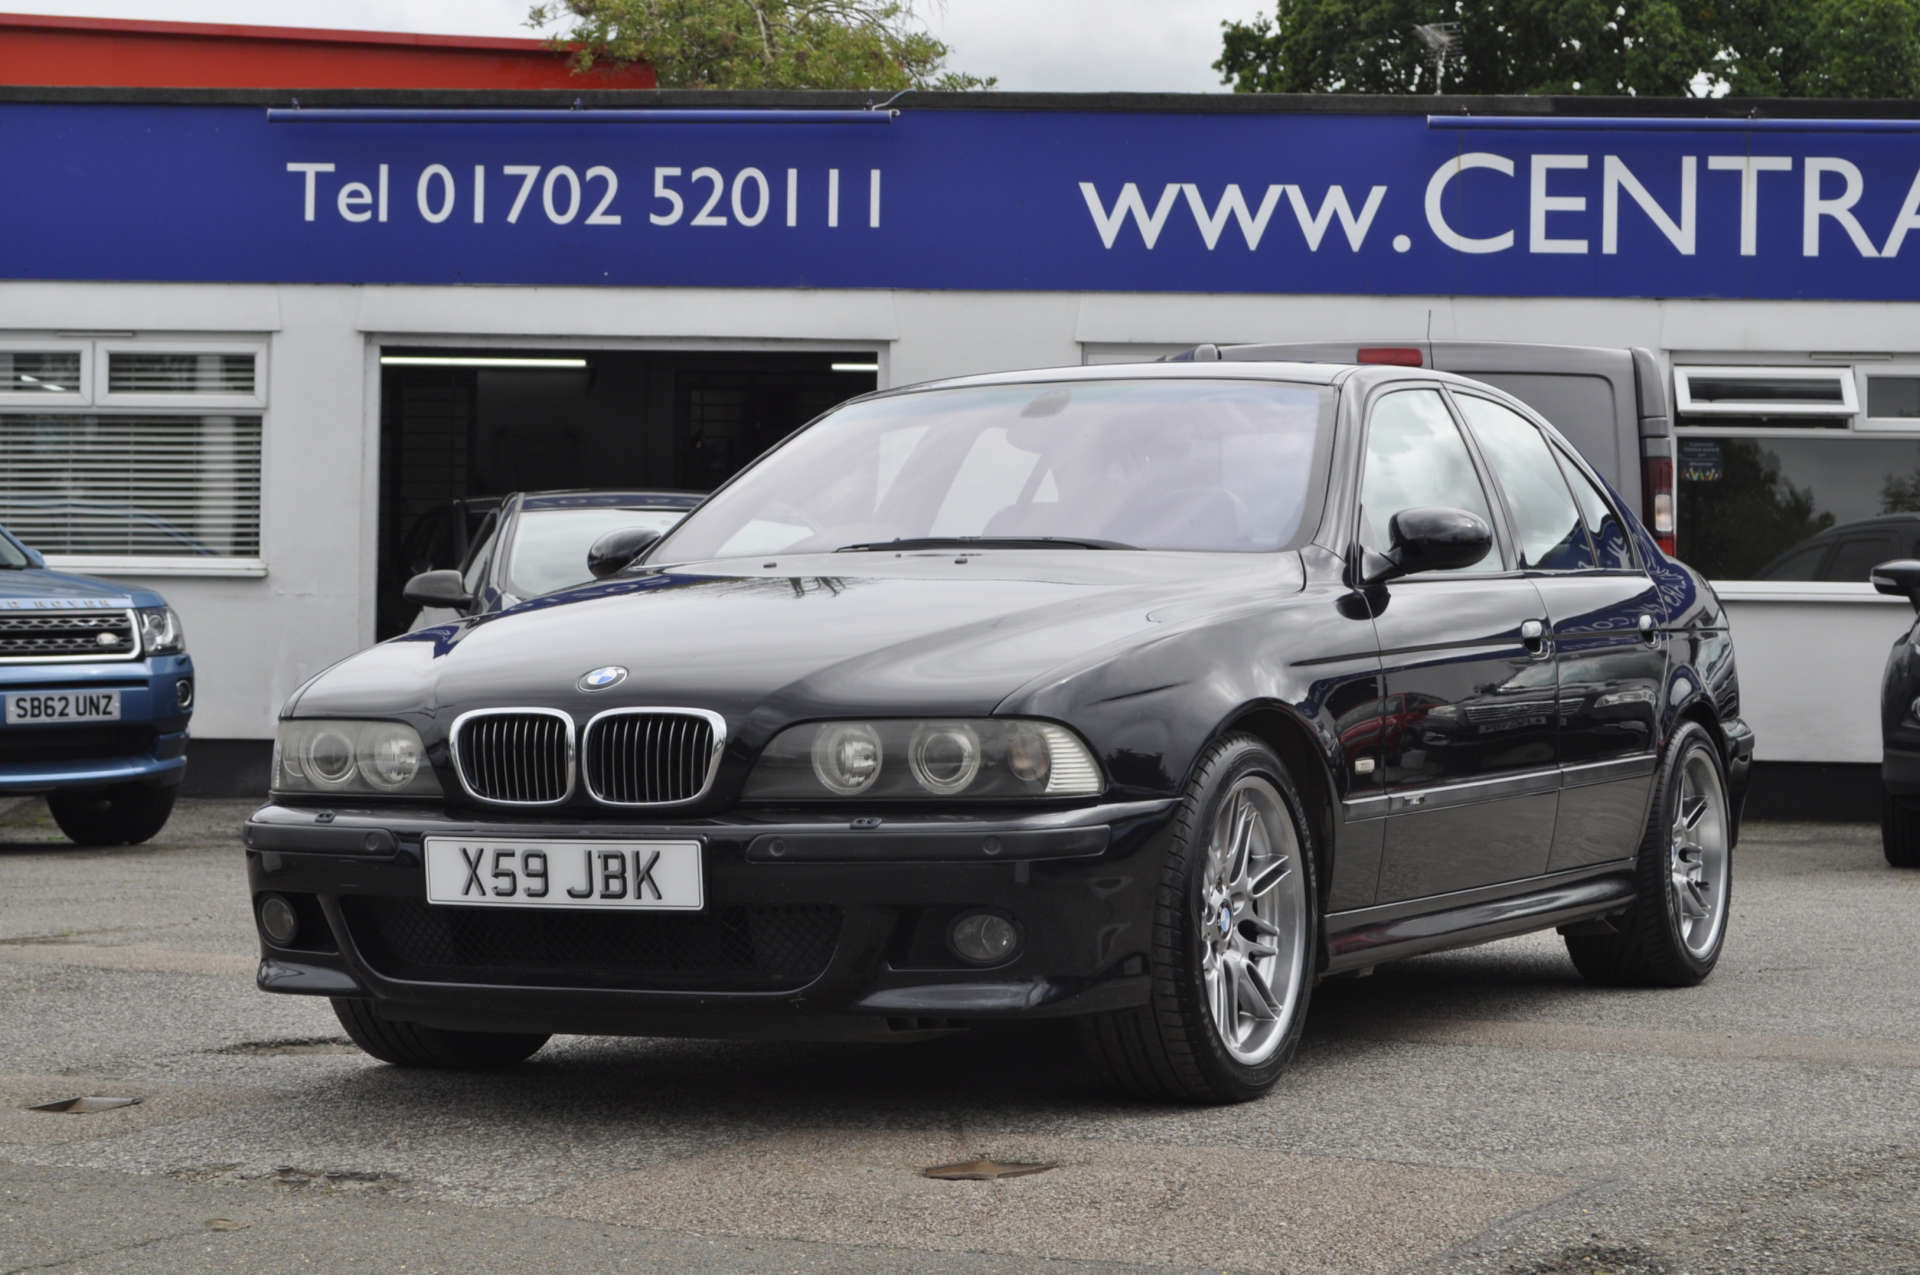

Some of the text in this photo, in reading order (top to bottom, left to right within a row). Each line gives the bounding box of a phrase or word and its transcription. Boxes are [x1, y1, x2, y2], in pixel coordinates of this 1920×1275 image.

[286, 162, 881, 228] Tel 01702 520111
[15, 694, 113, 719] SB62 UNZ
[459, 847, 663, 901] X59 JBK
